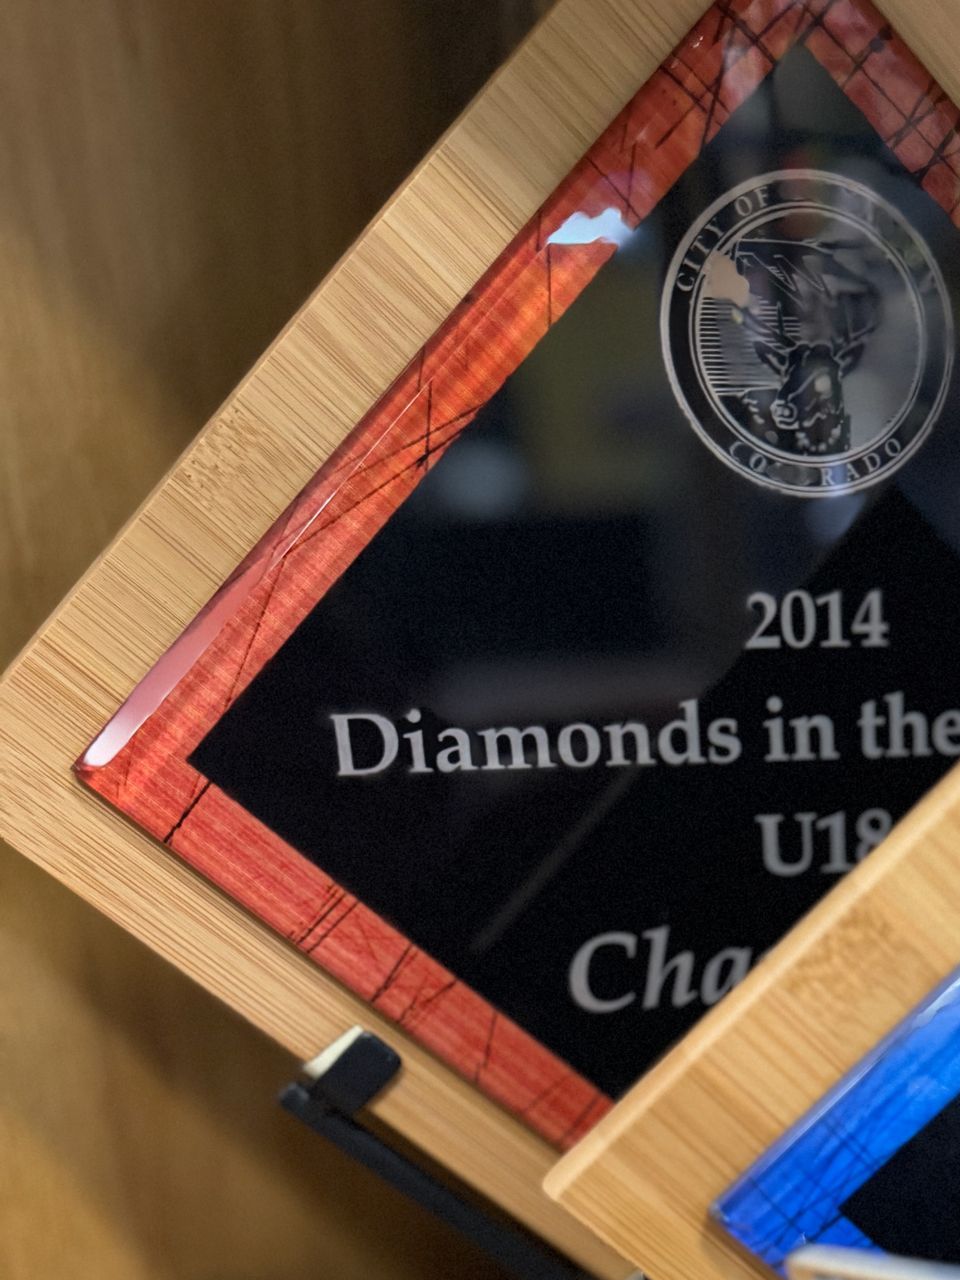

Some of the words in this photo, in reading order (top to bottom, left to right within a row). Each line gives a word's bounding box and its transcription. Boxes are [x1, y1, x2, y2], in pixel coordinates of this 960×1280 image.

[676, 220, 725, 292] CITY
[733, 186, 771, 217] OF
[729, 438, 902, 487] CORADO
[744, 589, 890, 650] 2014
[330, 699, 743, 777] Diamonds
[764, 696, 838, 763] in
[754, 808, 893, 877] U18
[568, 924, 760, 1014] Cha
